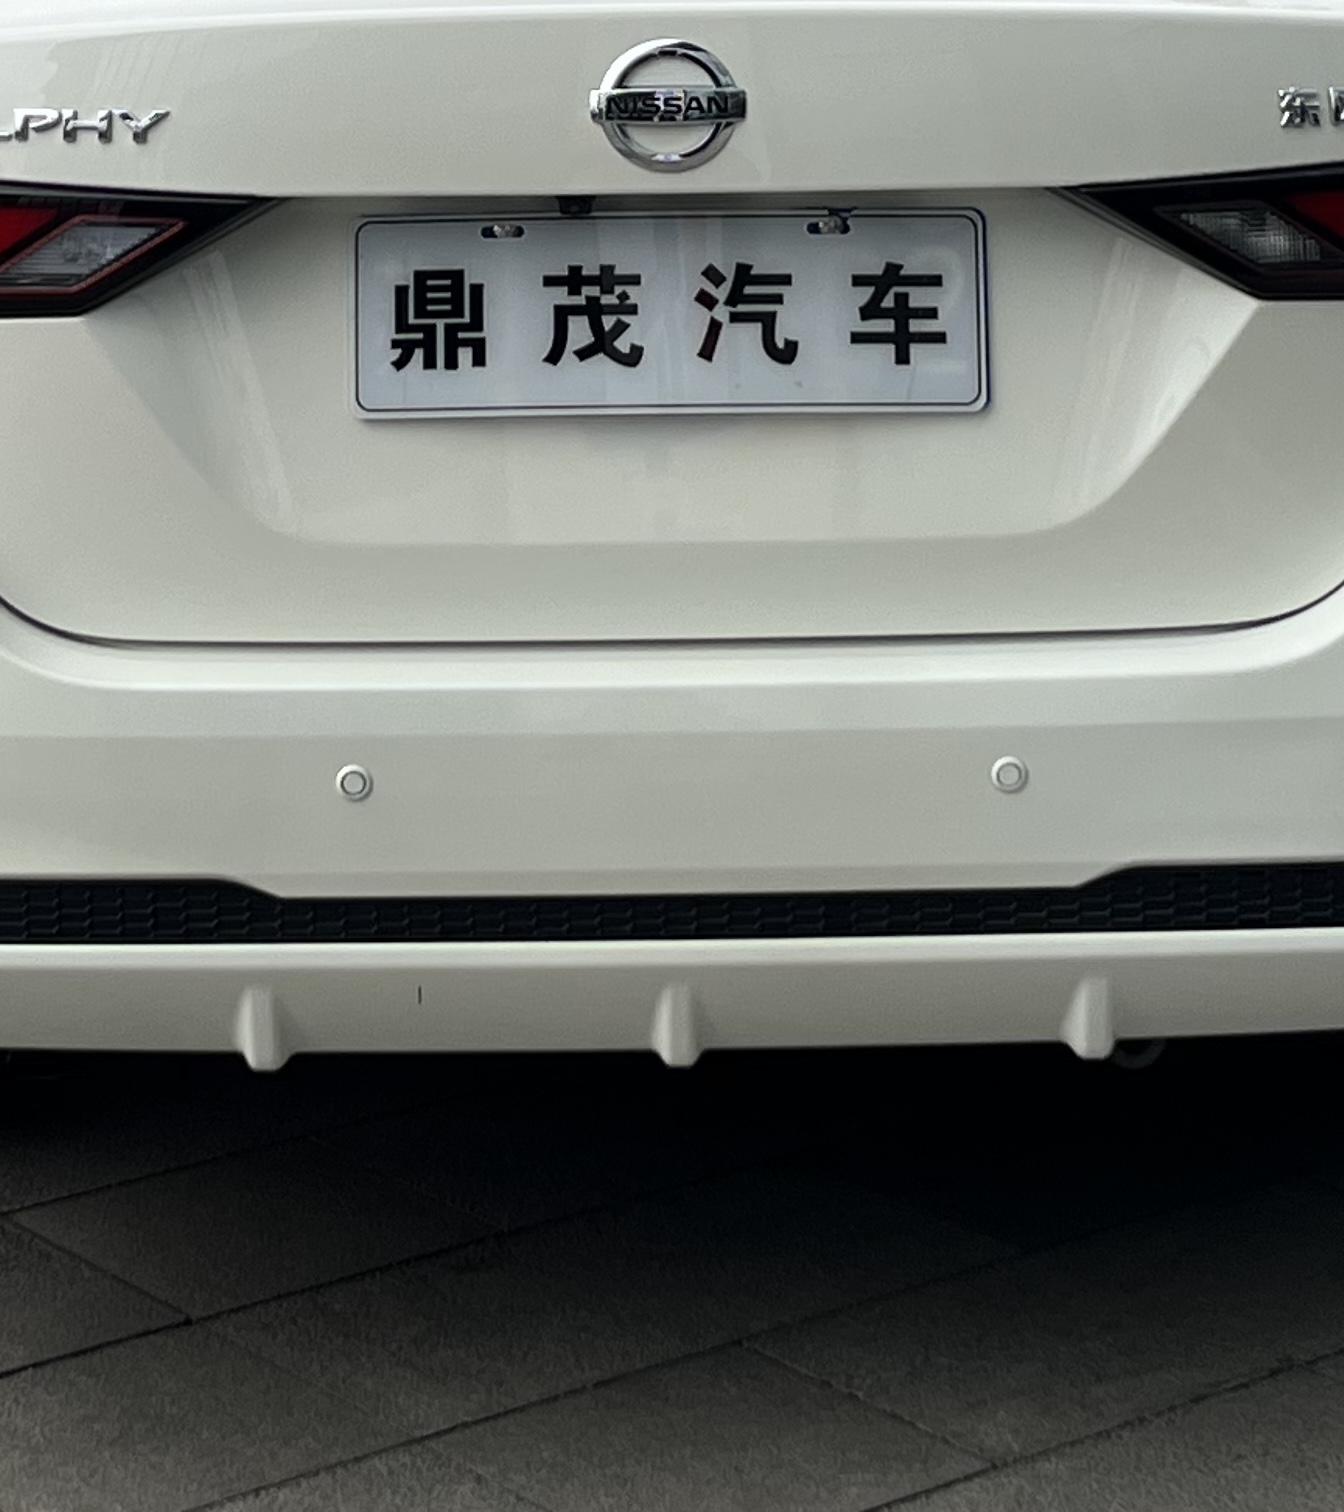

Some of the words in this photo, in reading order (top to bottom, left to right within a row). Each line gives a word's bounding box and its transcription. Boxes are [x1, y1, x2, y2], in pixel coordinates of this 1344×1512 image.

[607, 94, 729, 115] NISSAN
[390, 261, 948, 372] 鼎茂汽车
